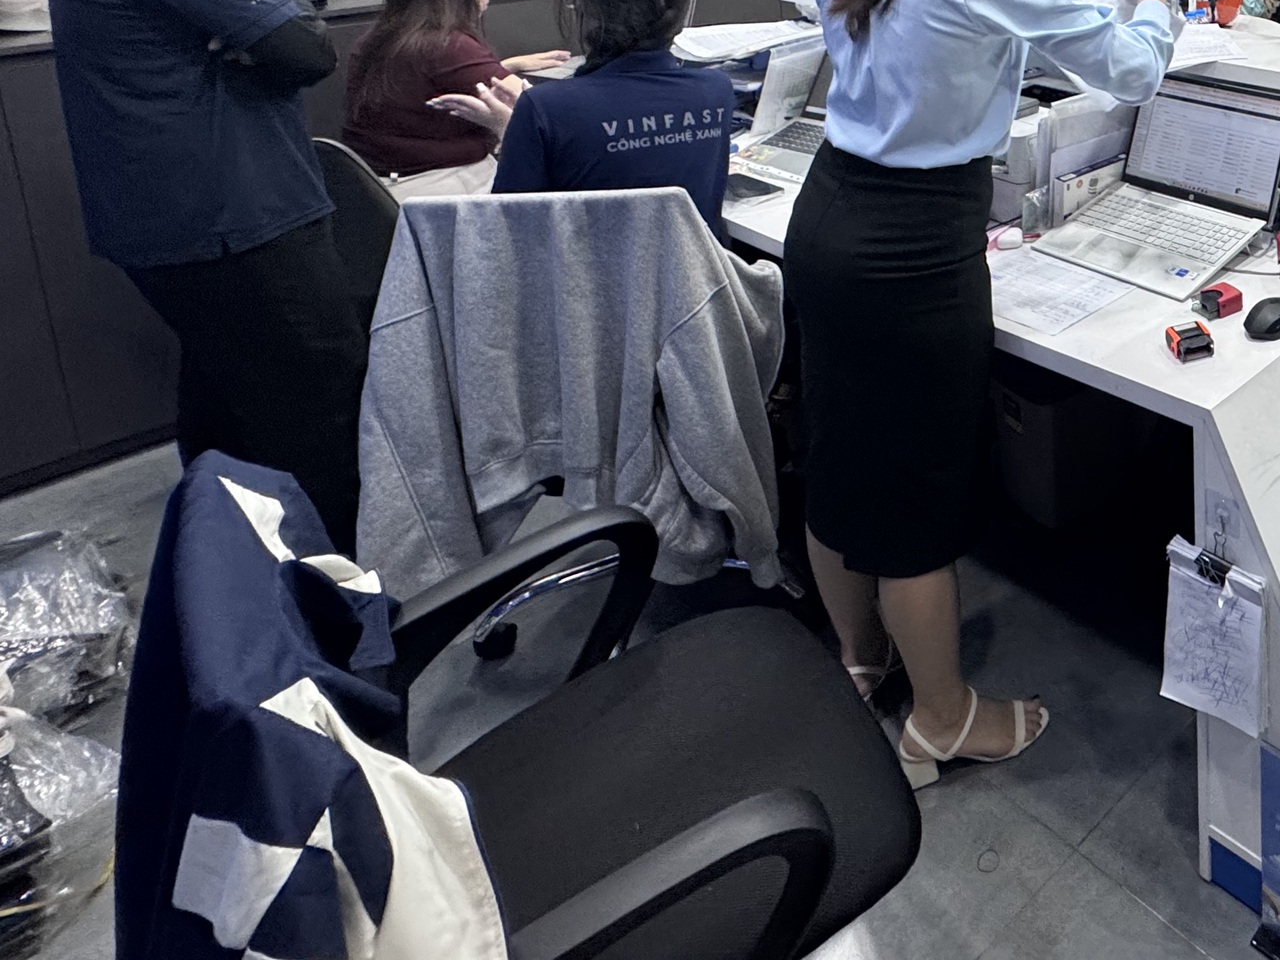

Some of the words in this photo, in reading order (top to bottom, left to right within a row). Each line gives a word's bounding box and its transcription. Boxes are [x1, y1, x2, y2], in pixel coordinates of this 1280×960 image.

[602, 108, 724, 136] VINFAST
[606, 137, 651, 152] CÔNG
[654, 130, 694, 146] NGHỆ
[695, 127, 722, 140] XANH
